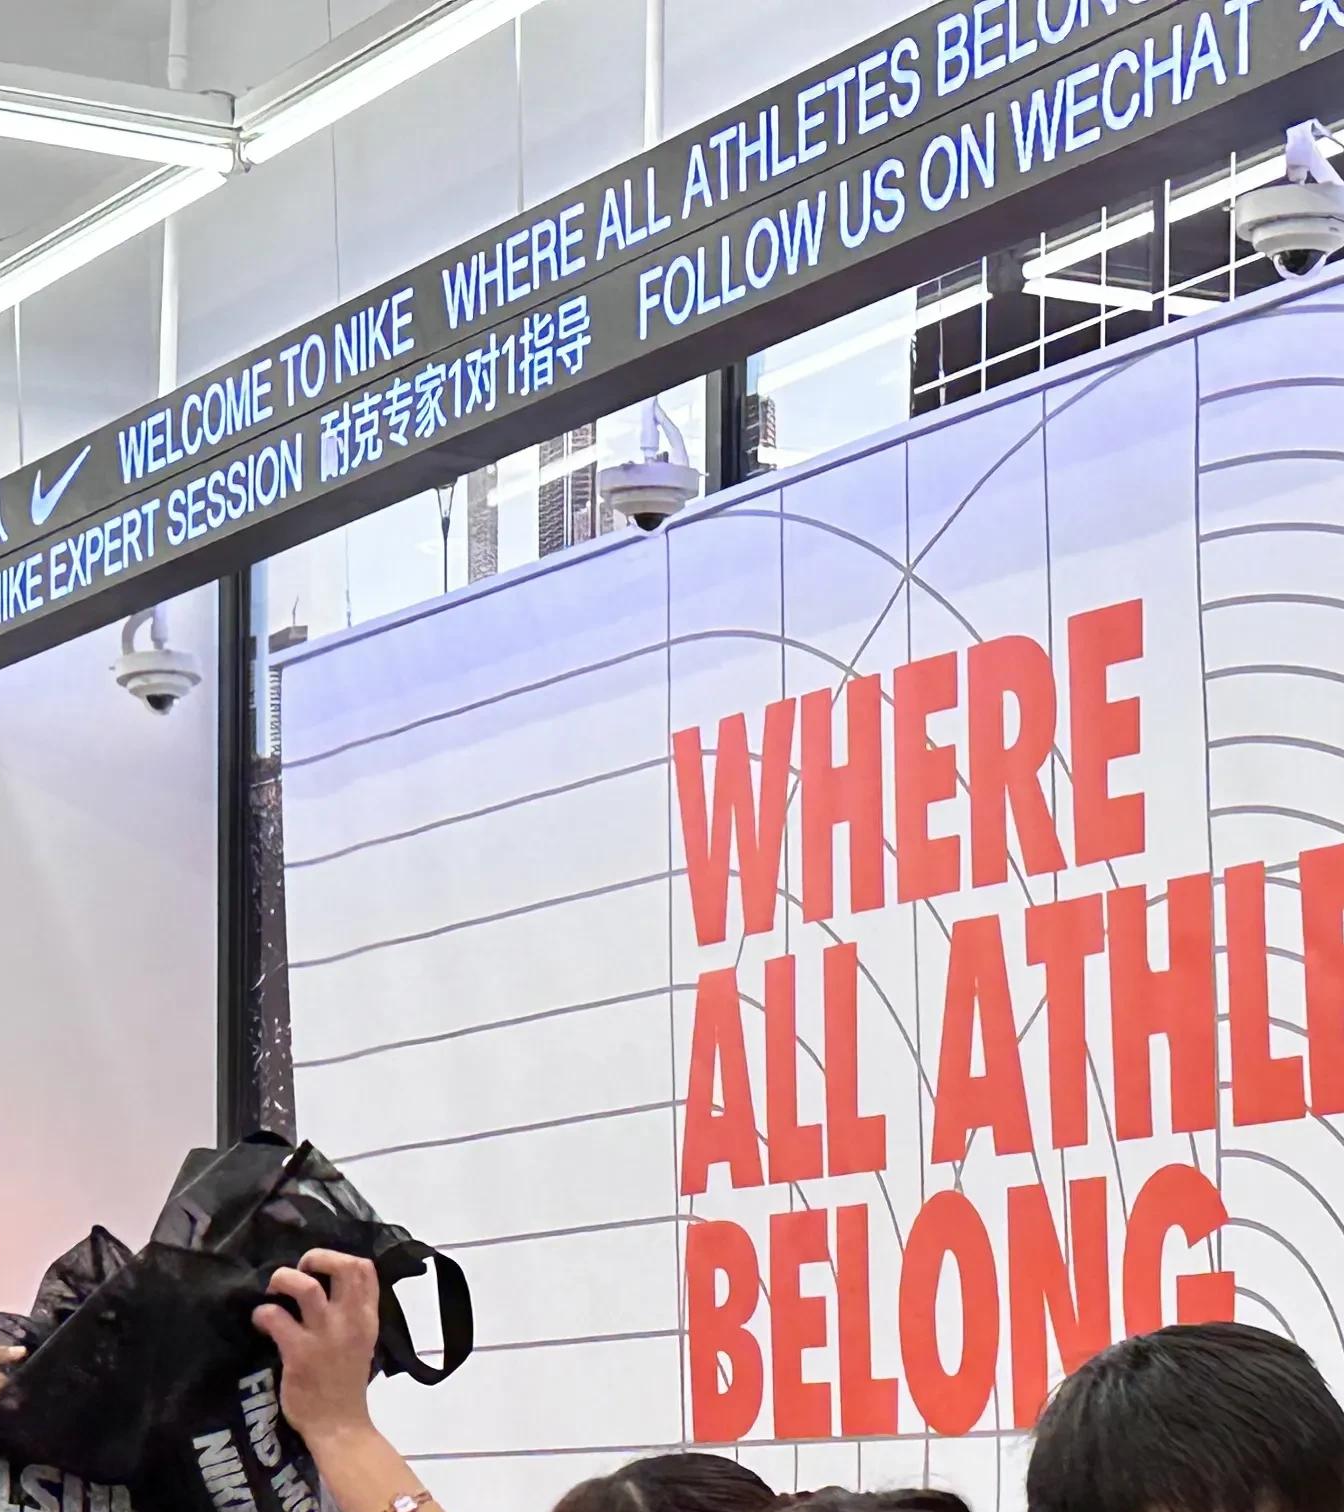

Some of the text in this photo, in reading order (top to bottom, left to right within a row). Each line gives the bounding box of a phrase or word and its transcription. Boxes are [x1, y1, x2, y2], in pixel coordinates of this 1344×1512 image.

[49, 498, 161, 600] EXPERT
[166, 433, 303, 546] SESSION
[320, 295, 592, 482] 耐克专家1对1指导
[639, 190, 827, 340] FOLLOW
[839, 159, 906, 249] US
[920, 112, 996, 211] ON
[1010, 0, 1256, 172] WECHAT
[118, 358, 272, 484] WELCOME
[279, 338, 327, 408] TO
[334, 287, 415, 384] NIKE
[442, 203, 586, 329] WHERE
[595, 167, 672, 261] ALL
[680, 37, 921, 220] ATHLETES
[673, 598, 1145, 947] WHERE
[680, 943, 887, 1196] ALL
[239, 1367, 282, 1467] FIND
[686, 1162, 1236, 1443] BELONG
